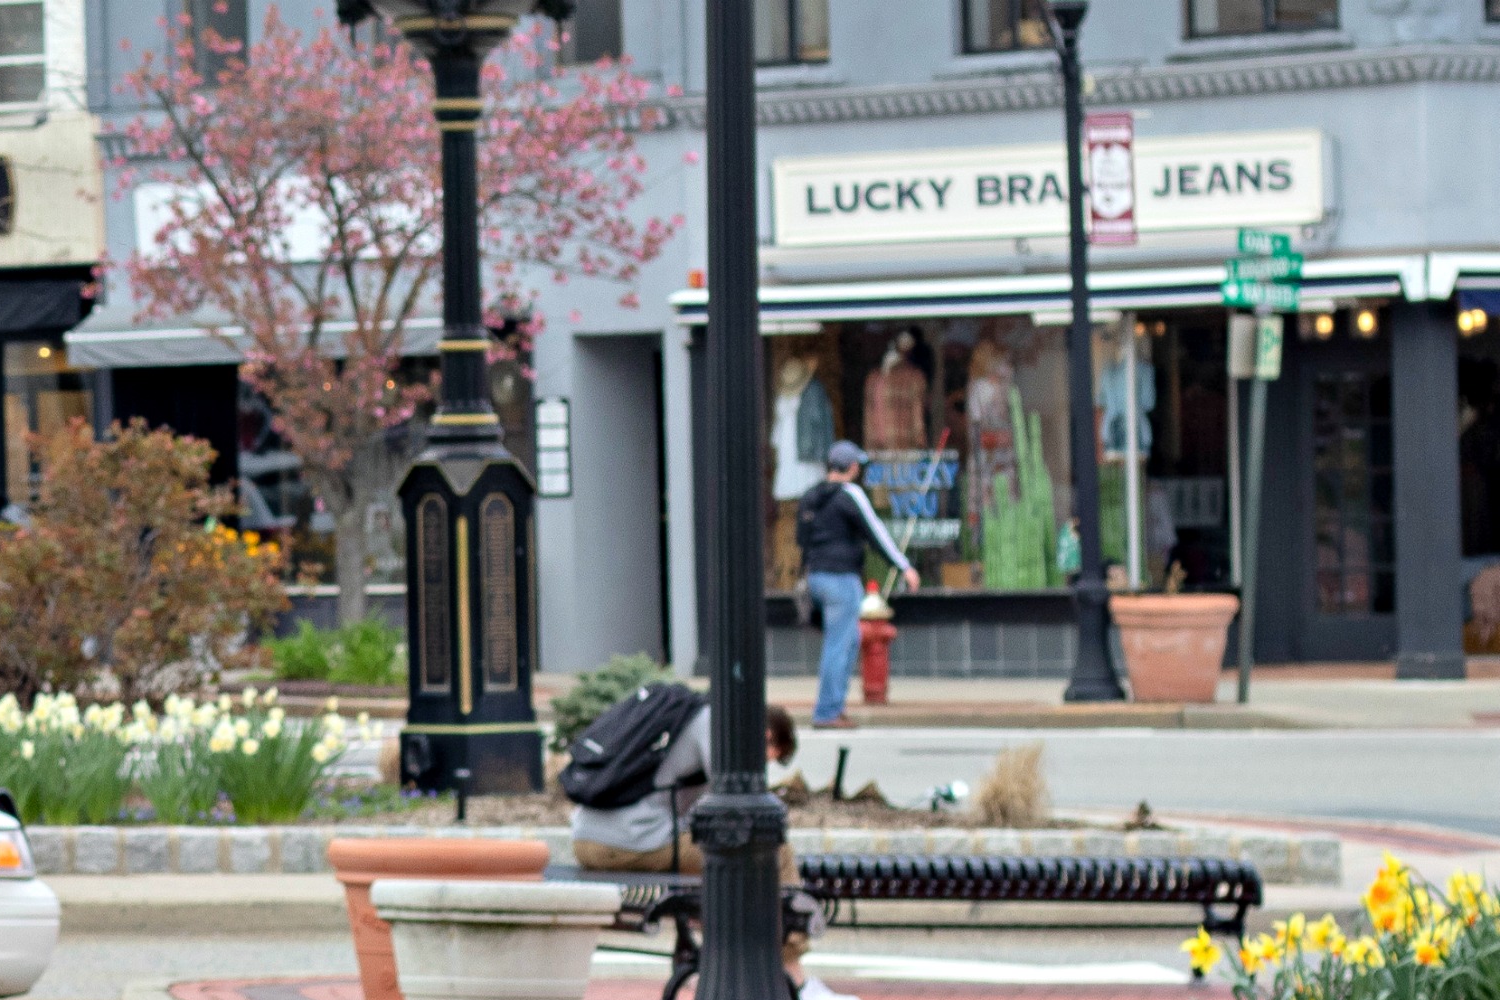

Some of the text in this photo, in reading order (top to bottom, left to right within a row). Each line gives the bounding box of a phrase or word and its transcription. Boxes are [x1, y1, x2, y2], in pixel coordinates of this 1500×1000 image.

[805, 160, 1293, 214] LUCKY BRA JEANS
